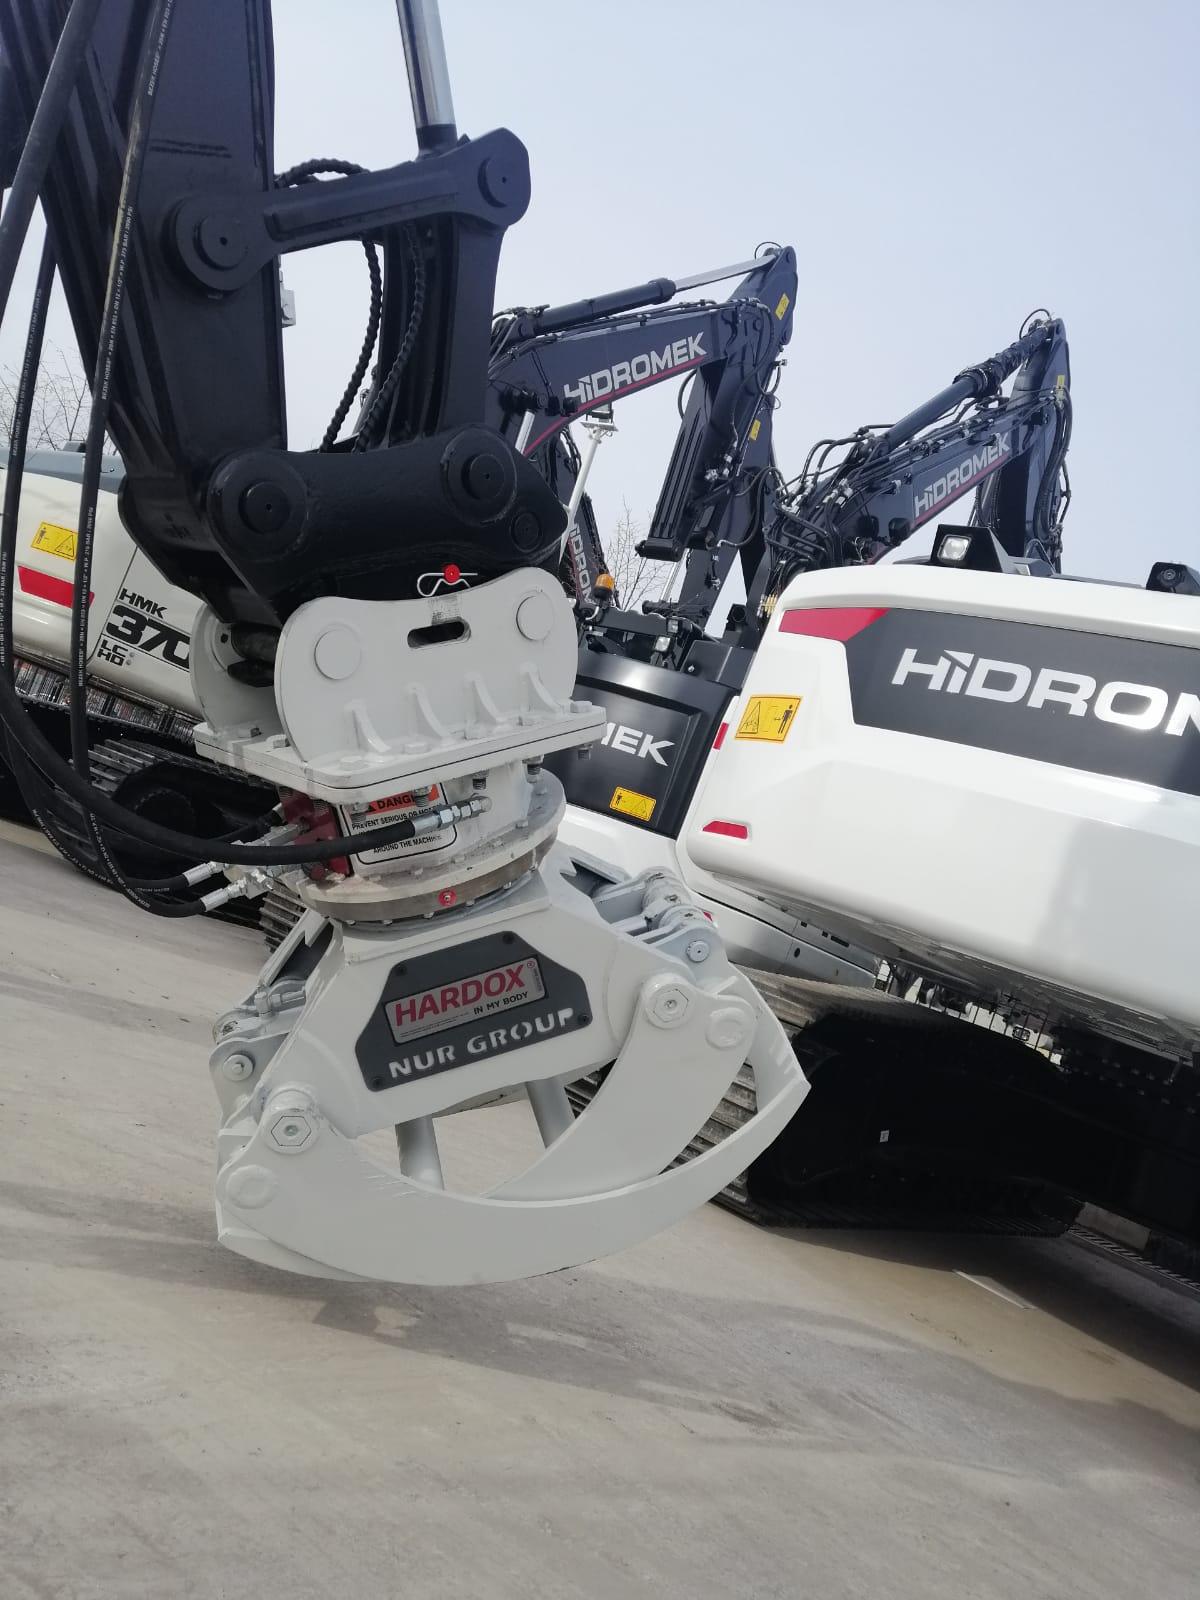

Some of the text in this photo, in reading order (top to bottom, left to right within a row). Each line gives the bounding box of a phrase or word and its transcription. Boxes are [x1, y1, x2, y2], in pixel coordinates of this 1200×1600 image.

[119, 587, 168, 619] HMK
[97, 648, 125, 667] HD
[101, 639, 128, 657] LC
[400, 839, 414, 849] THE
[395, 964, 526, 1026] HARDOX
[474, 991, 529, 1016] IN MY BODY
[389, 1045, 456, 1078] NUR
[466, 1007, 574, 1054] GROUP
